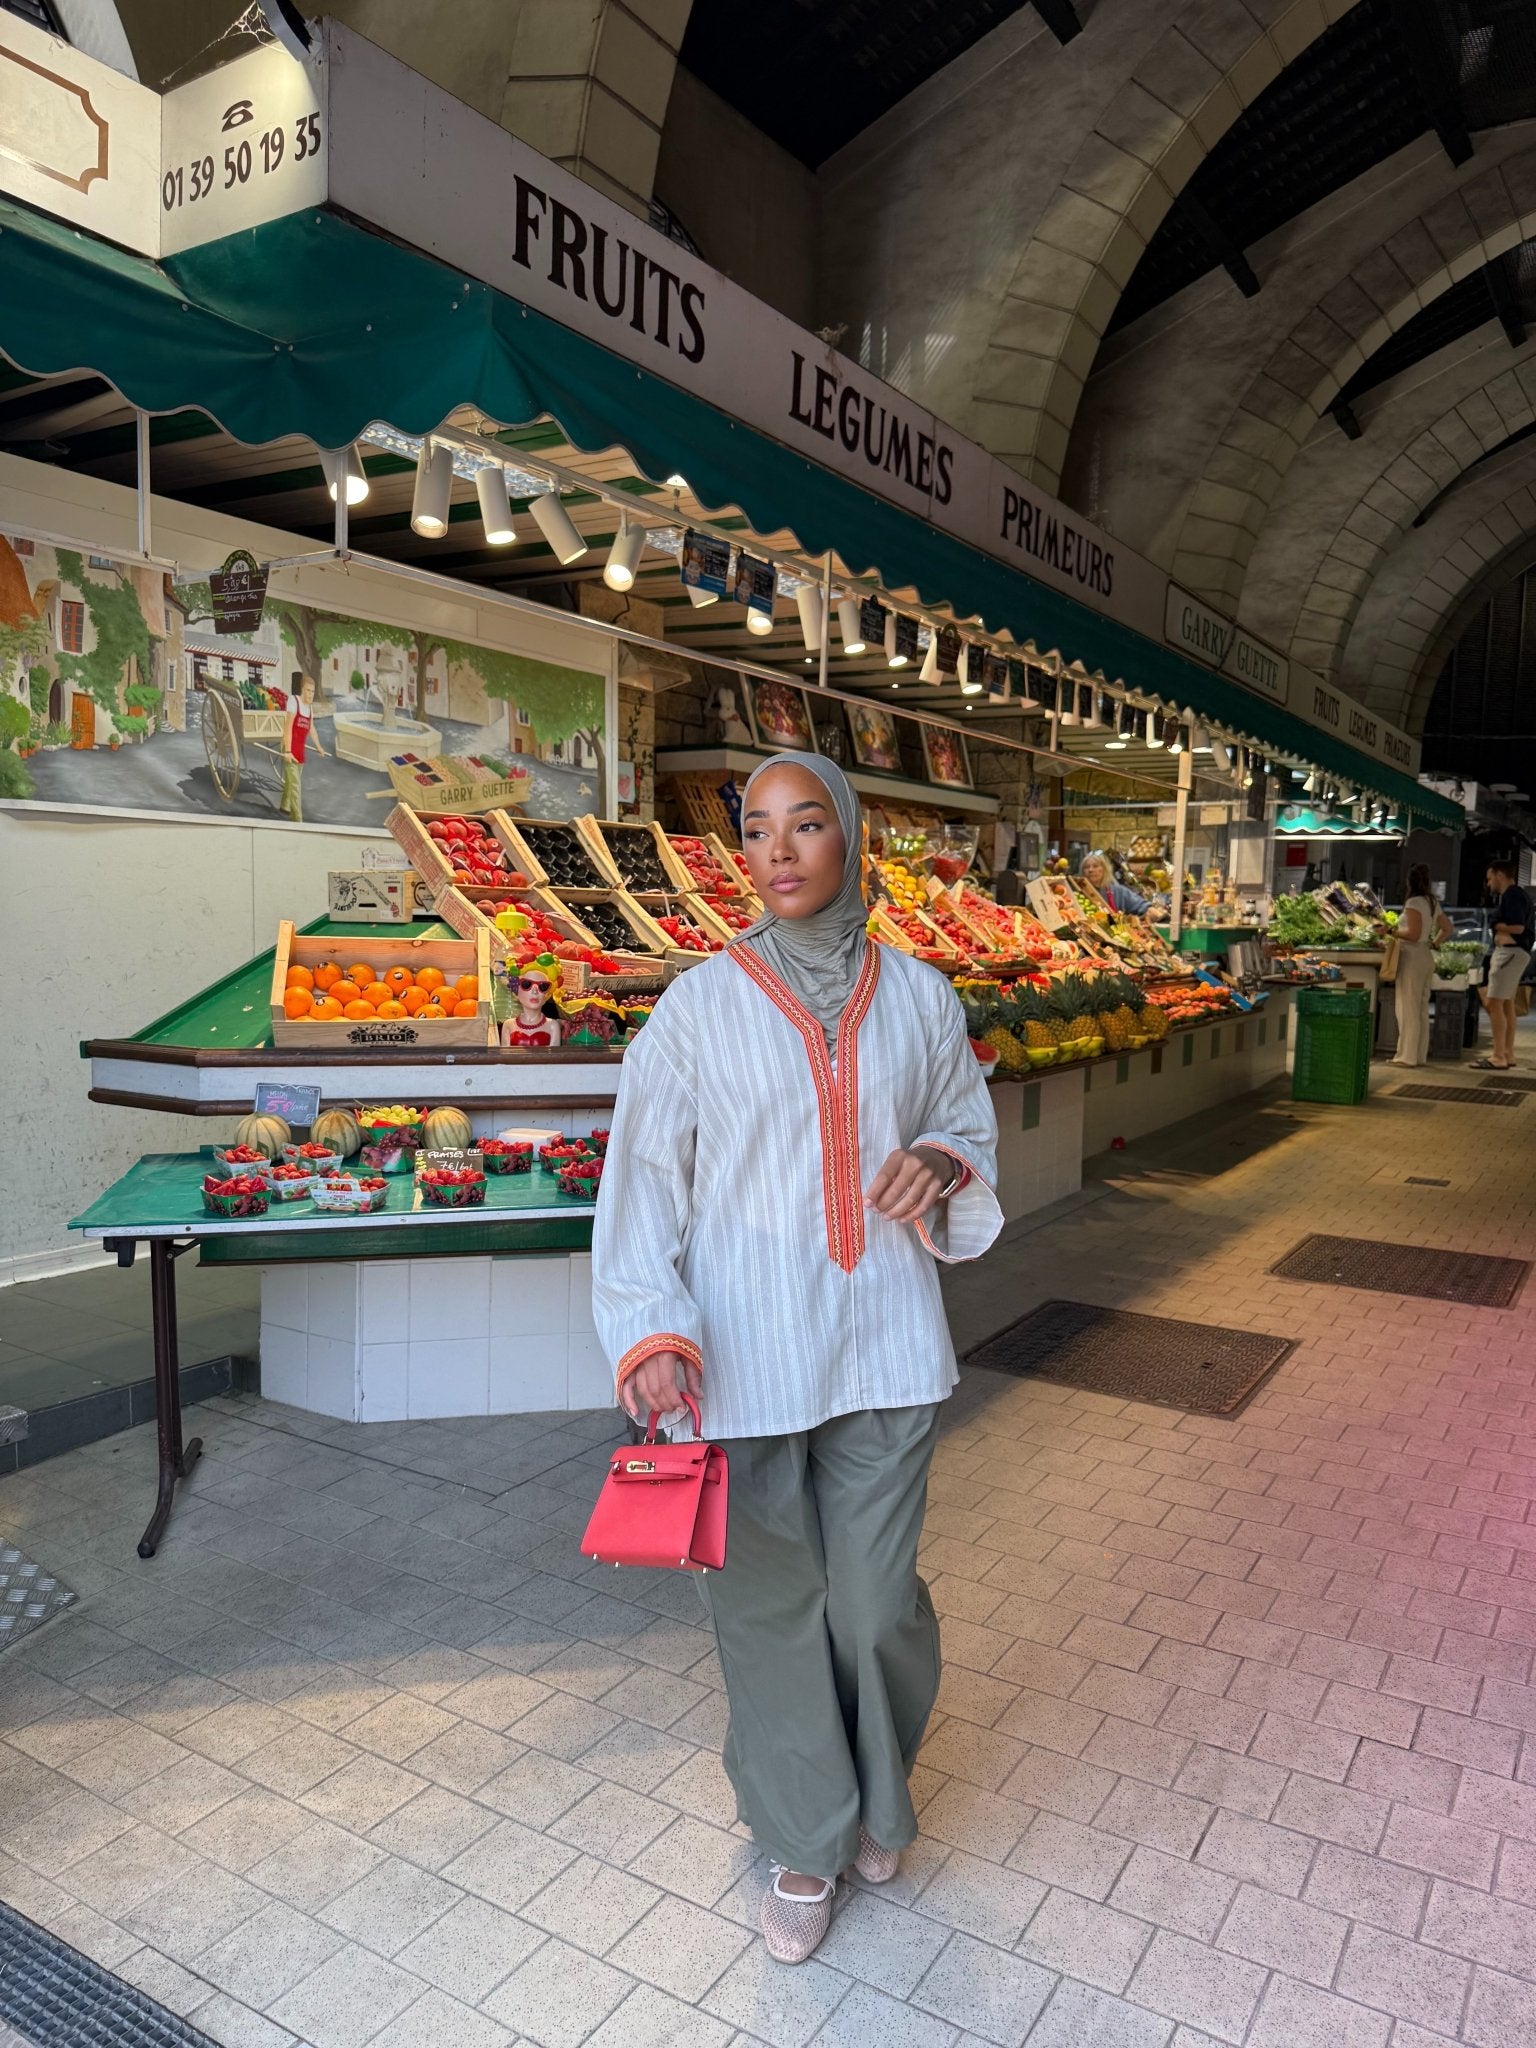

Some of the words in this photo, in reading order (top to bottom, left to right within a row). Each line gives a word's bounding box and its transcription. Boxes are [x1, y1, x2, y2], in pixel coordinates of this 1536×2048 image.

[162, 167, 184, 212] 01
[190, 155, 215, 202] 39
[224, 140, 253, 190] 50
[259, 126, 285, 175] 19
[294, 111, 322, 162] 35
[511, 173, 706, 364] FRUITS
[788, 349, 954, 506] LEGUMES
[1000, 485, 1115, 598] PRIMEURS
[1182, 606, 1228, 659] GARRY
[1237, 640, 1279, 691] GUETTE
[1313, 686, 1340, 727] FRUITS
[440, 786, 473, 805] GARRY
[482, 781, 515, 799] GUETTE
[365, 1034, 402, 1042] BRIO
[427, 1150, 465, 1159] FRAISES
